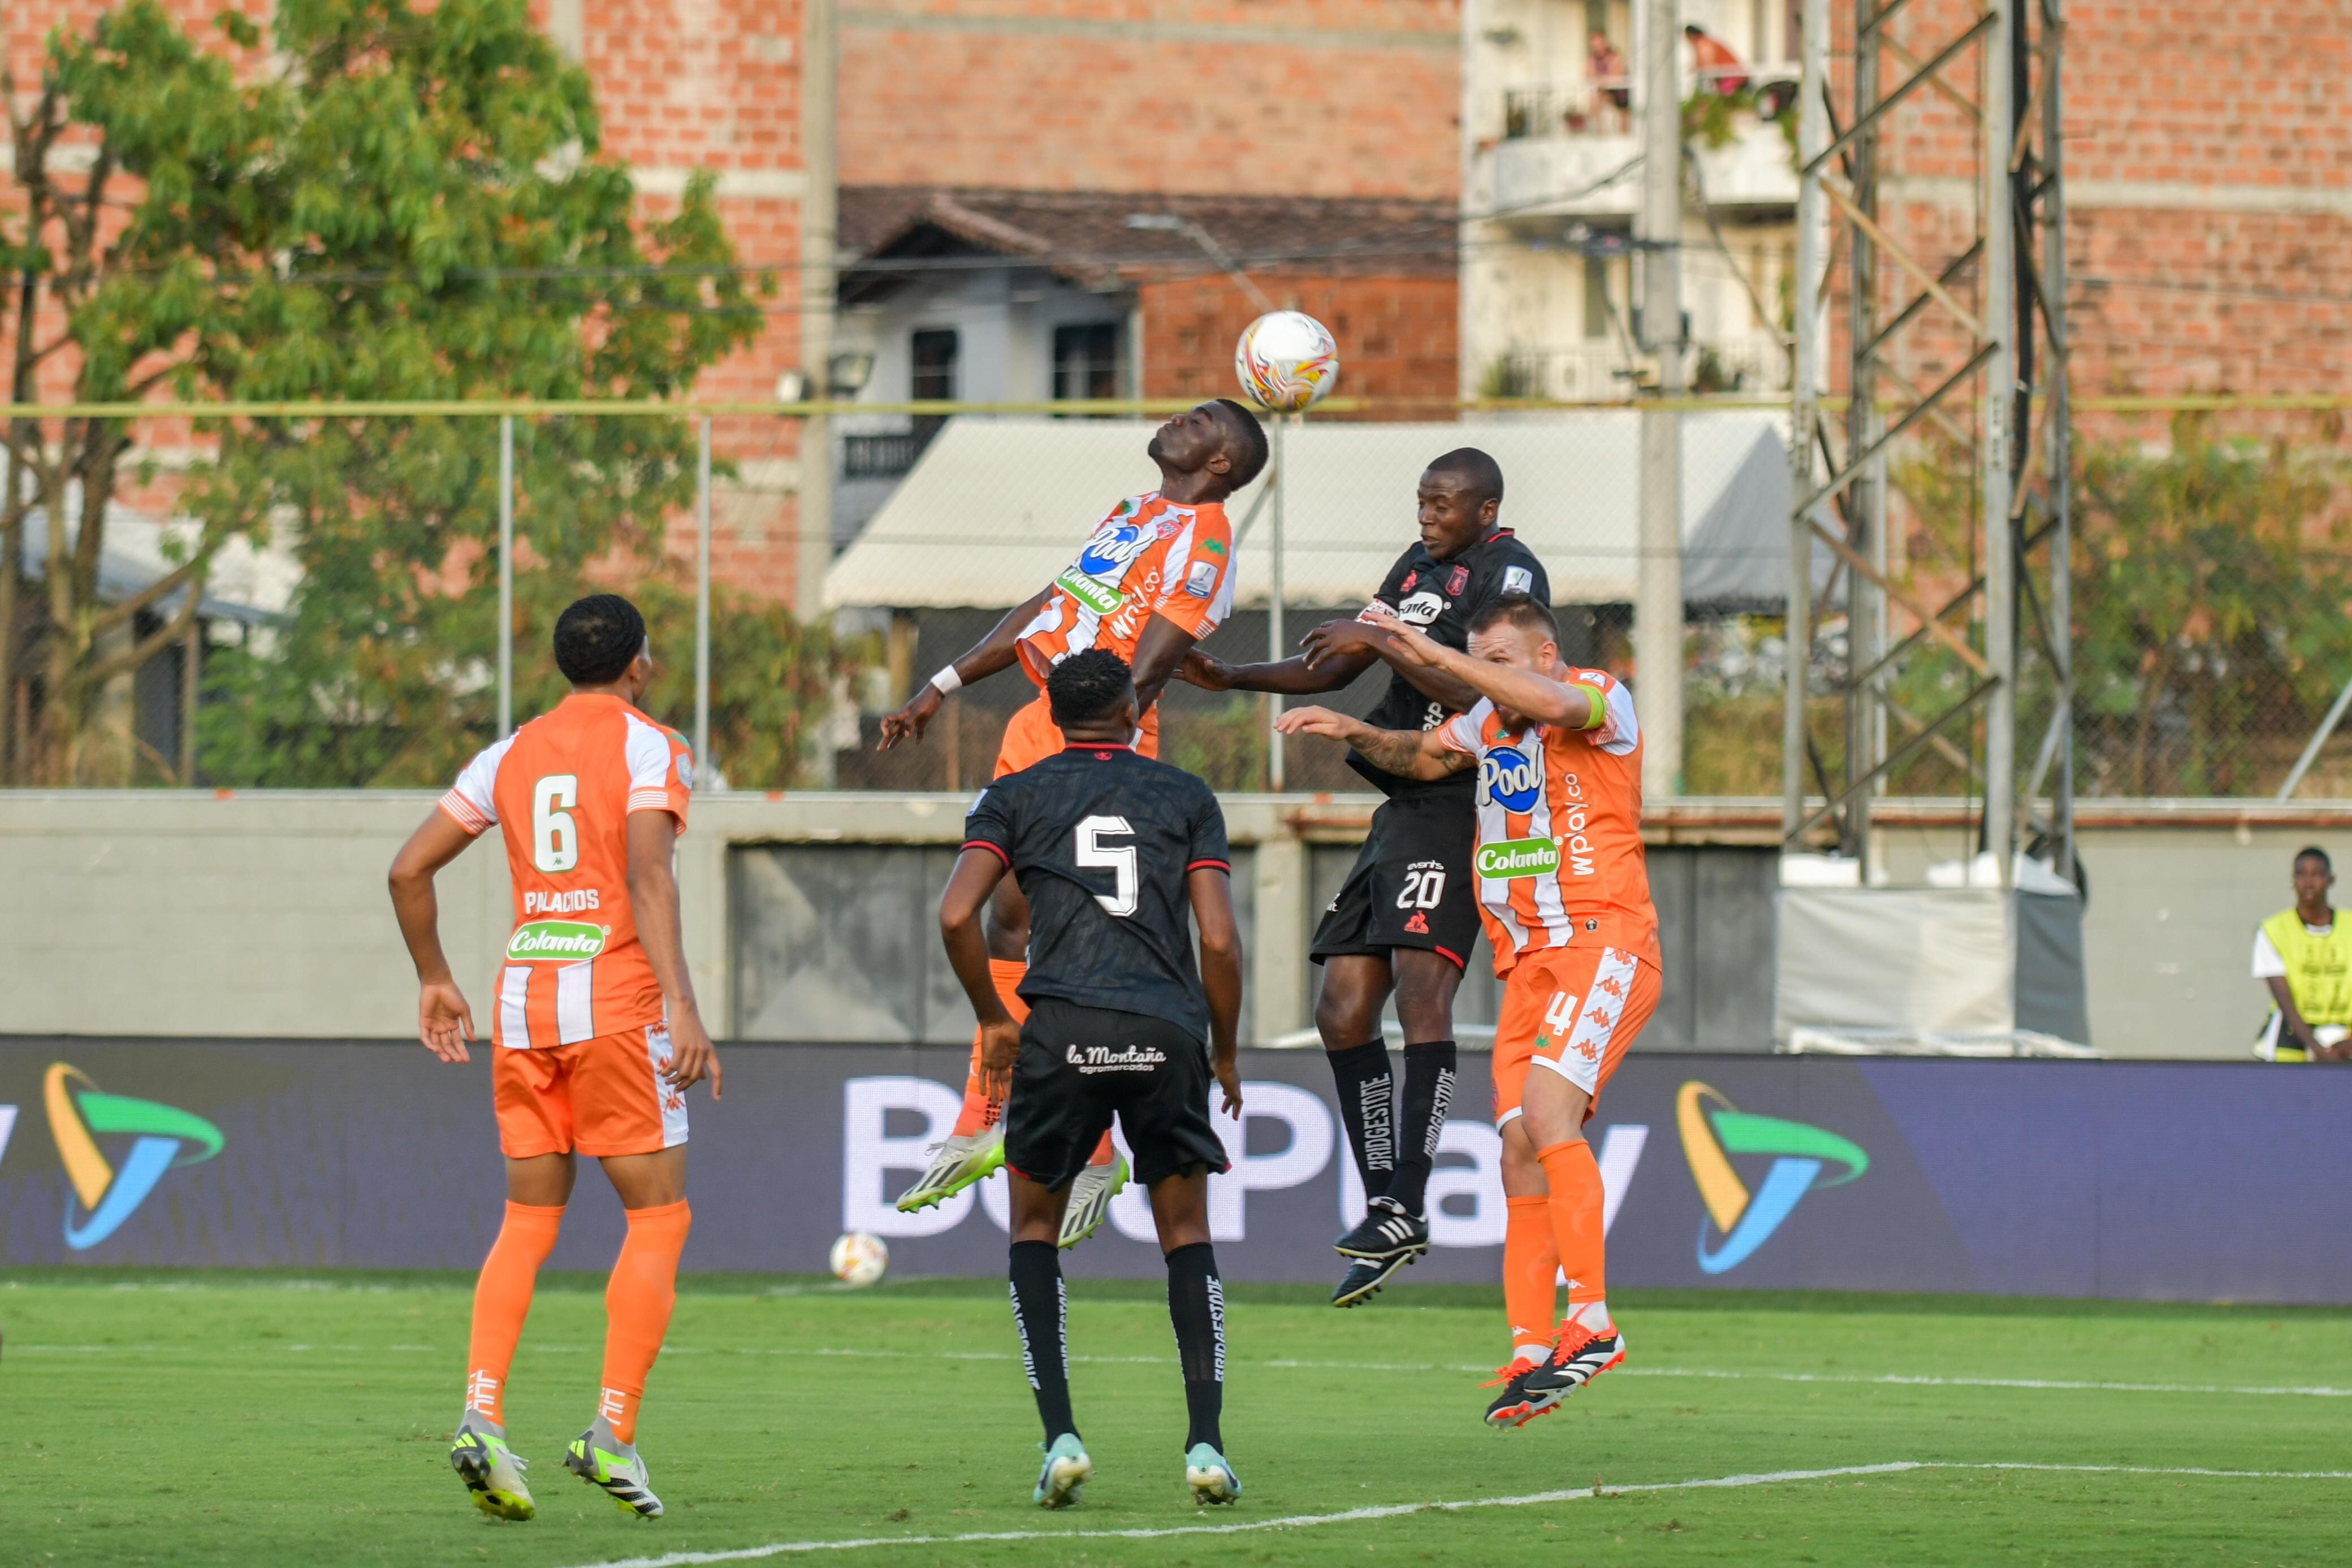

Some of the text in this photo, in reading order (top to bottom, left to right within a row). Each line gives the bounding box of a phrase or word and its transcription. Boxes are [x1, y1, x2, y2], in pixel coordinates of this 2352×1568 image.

[1086, 528, 1153, 563] Pool
[1062, 568, 1118, 610] olanta
[1480, 743, 1542, 805] Pool
[533, 775, 578, 872] 6
[1076, 815, 1139, 917] 5
[1478, 847, 1556, 871] Colanta
[525, 889, 599, 914] PALACIOS
[1396, 870, 1446, 909] 20
[510, 929, 602, 953] Colanta
[1066, 1043, 1167, 1064] la Montaña
[1079, 1063, 1155, 1075] agromercados
[1360, 1072, 1393, 1171] BRIDGESTONE
[1423, 1067, 1456, 1159] BRIDGESTONE
